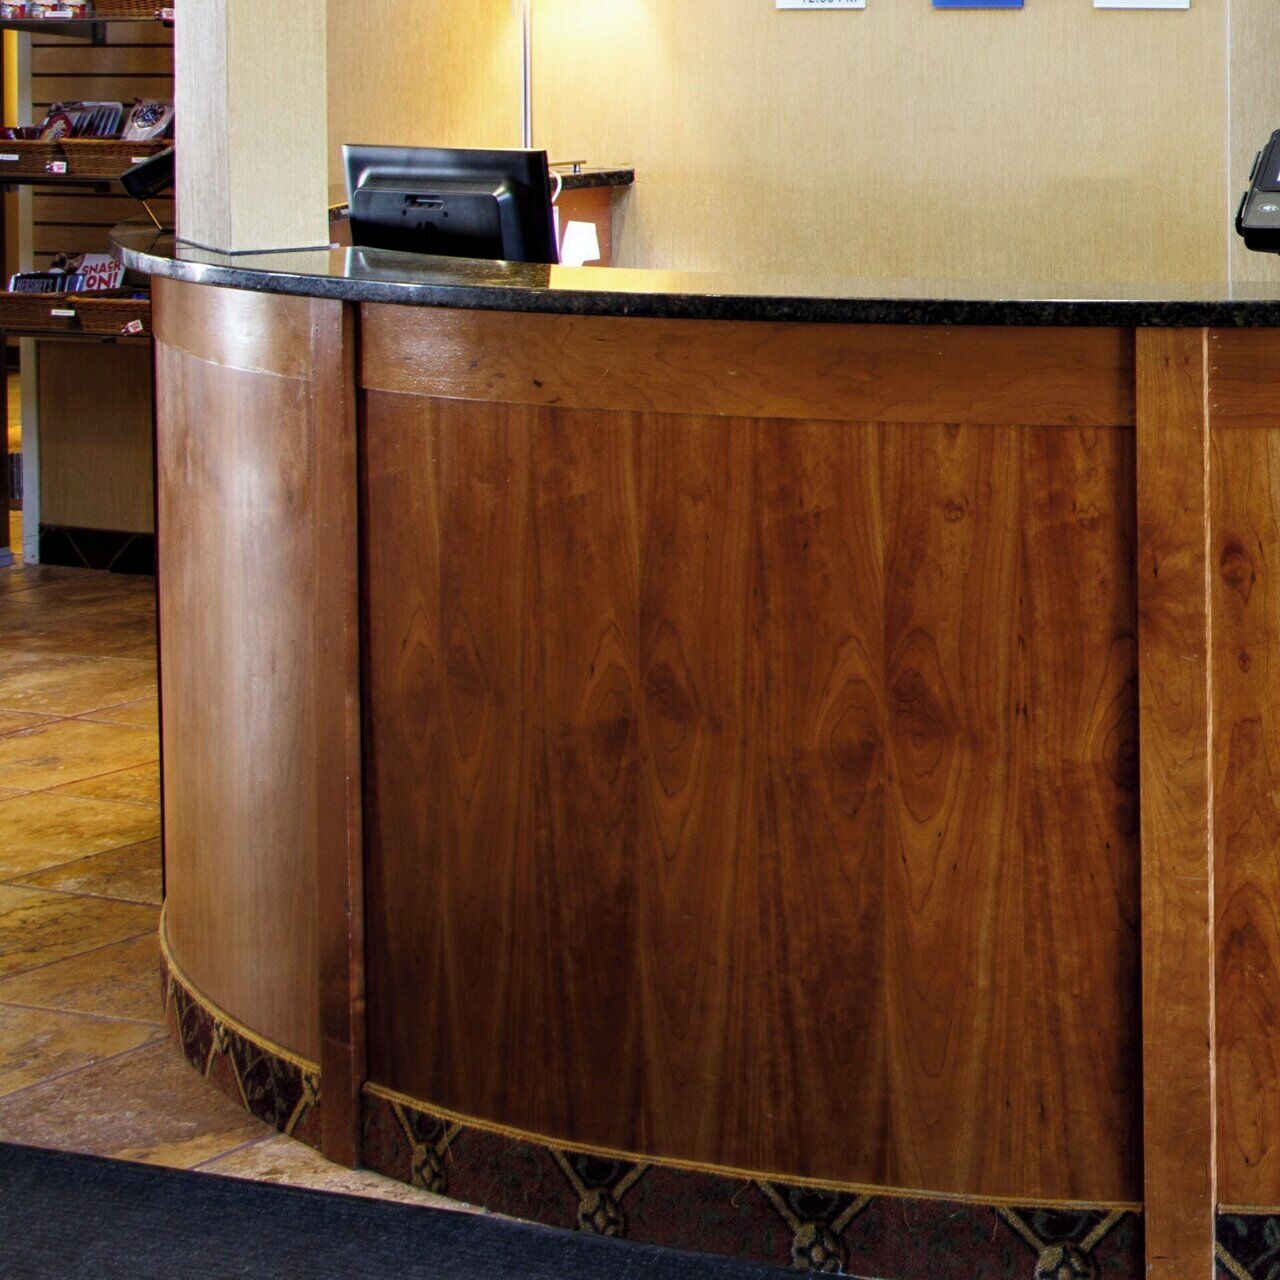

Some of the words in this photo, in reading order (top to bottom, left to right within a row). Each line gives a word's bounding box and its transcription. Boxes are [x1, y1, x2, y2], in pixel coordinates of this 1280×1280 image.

[82, 261, 121, 275] SNACK
[16, 279, 54, 292] HERSHEY'S
[85, 271, 118, 289] ON!
